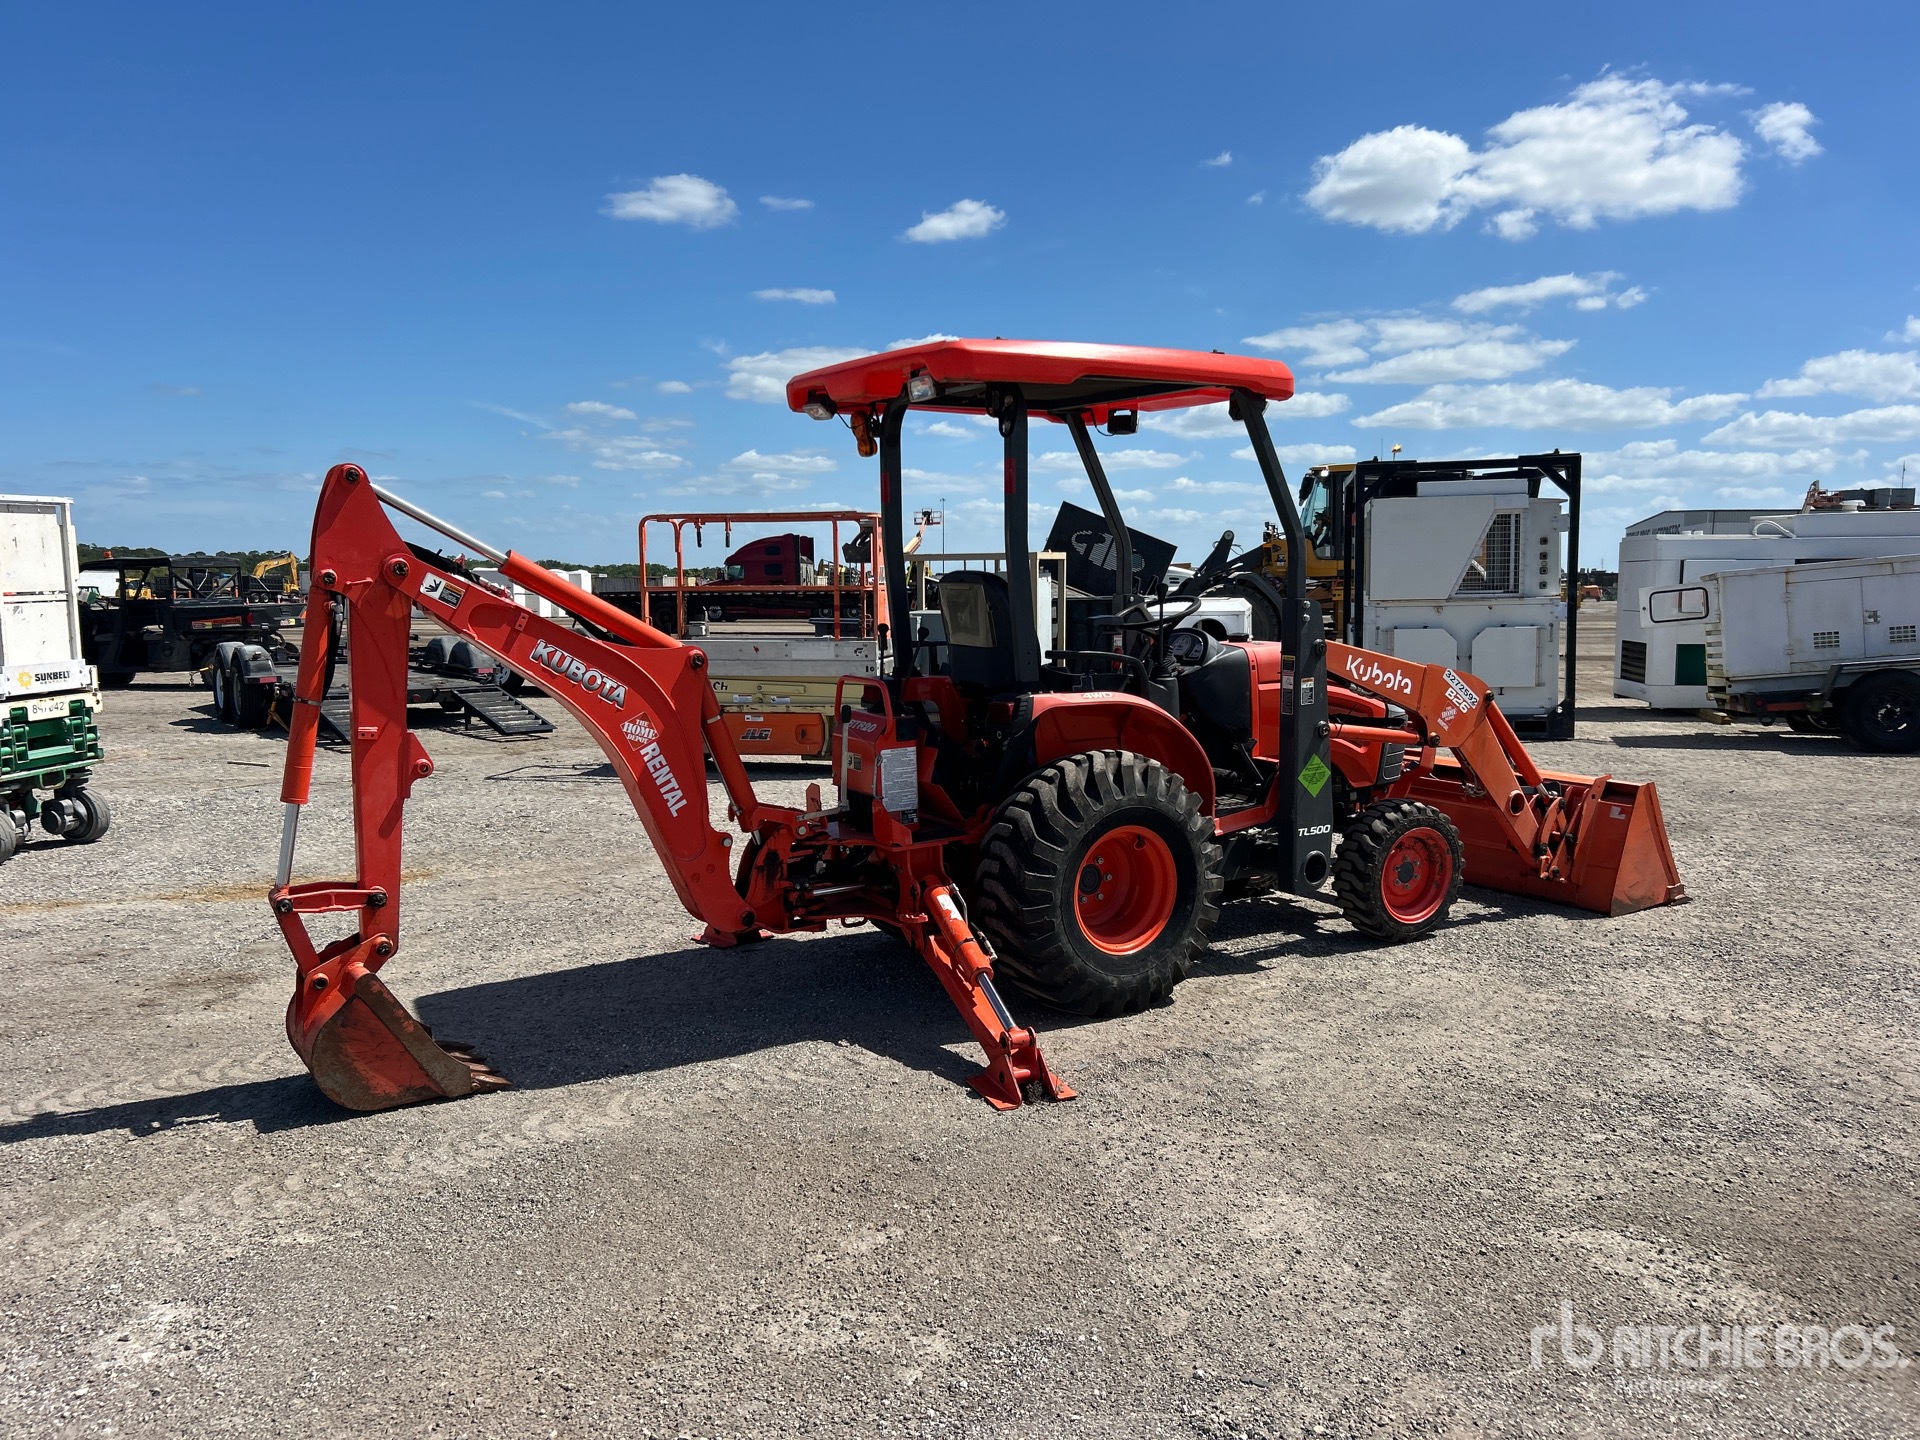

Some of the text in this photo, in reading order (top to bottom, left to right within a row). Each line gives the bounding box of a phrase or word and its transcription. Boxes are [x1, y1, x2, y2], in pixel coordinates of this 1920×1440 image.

[34, 670, 71, 682] SUNBELT
[530, 640, 627, 709] KUBOTA
[1345, 654, 1412, 695] Kubota
[1445, 670, 1478, 706] 3272592
[1444, 687, 1471, 714] B26
[623, 721, 657, 740] HOME
[635, 719, 650, 728] THE
[627, 733, 648, 745] DEPOT
[740, 728, 773, 741] JLG
[640, 741, 688, 818] RENTAL
[1298, 824, 1331, 837] TL500
